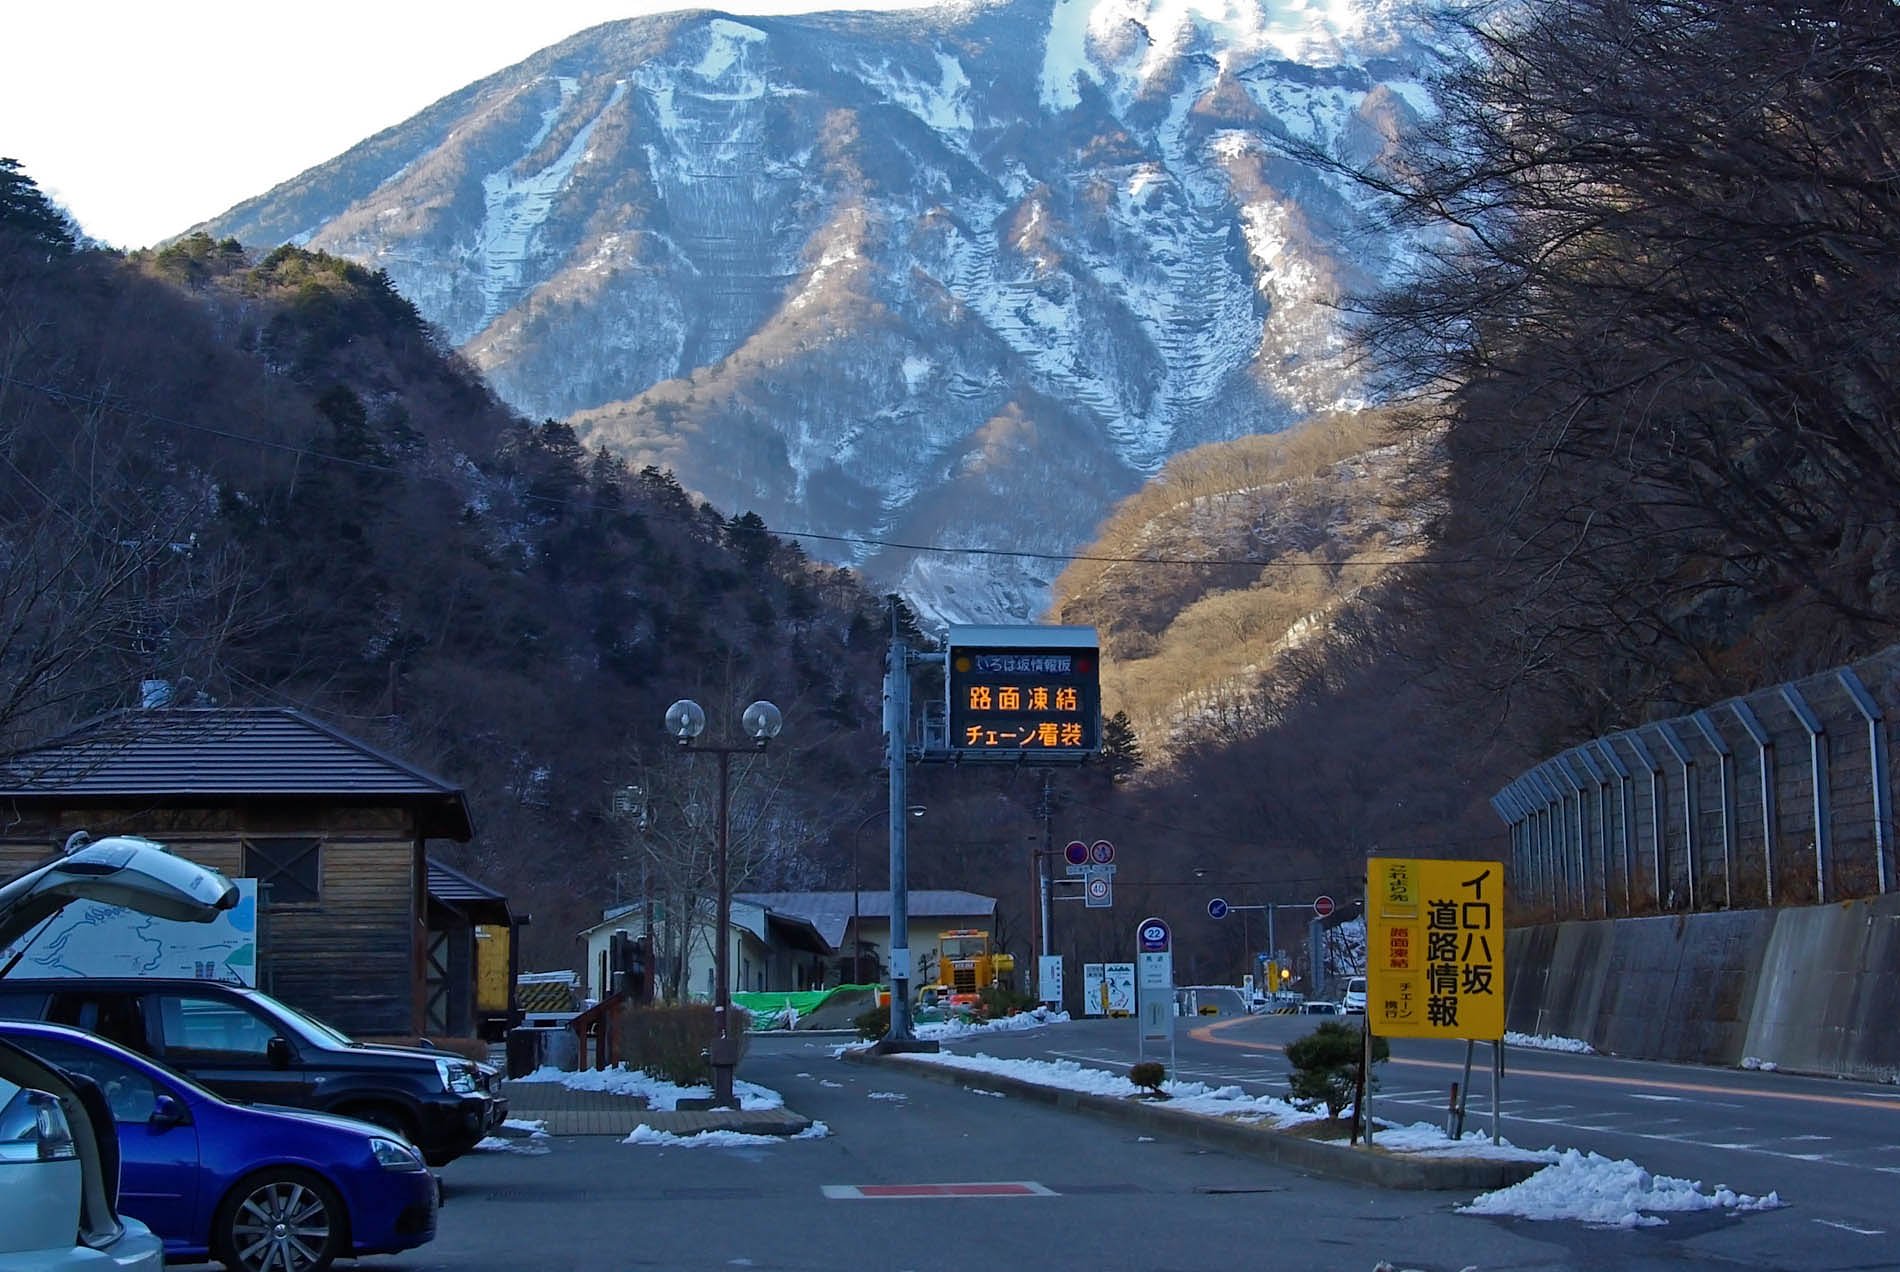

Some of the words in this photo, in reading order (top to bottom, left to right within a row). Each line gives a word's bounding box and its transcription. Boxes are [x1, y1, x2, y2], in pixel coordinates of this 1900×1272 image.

[970, 686, 1077, 711] 路面凍結
[966, 722, 1082, 747] チェーン着装
[1093, 883, 1106, 893] 40
[1148, 929, 1161, 938] 22
[1461, 869, 1493, 995] イロハ坂
[1427, 899, 1459, 1028] 道路情報
